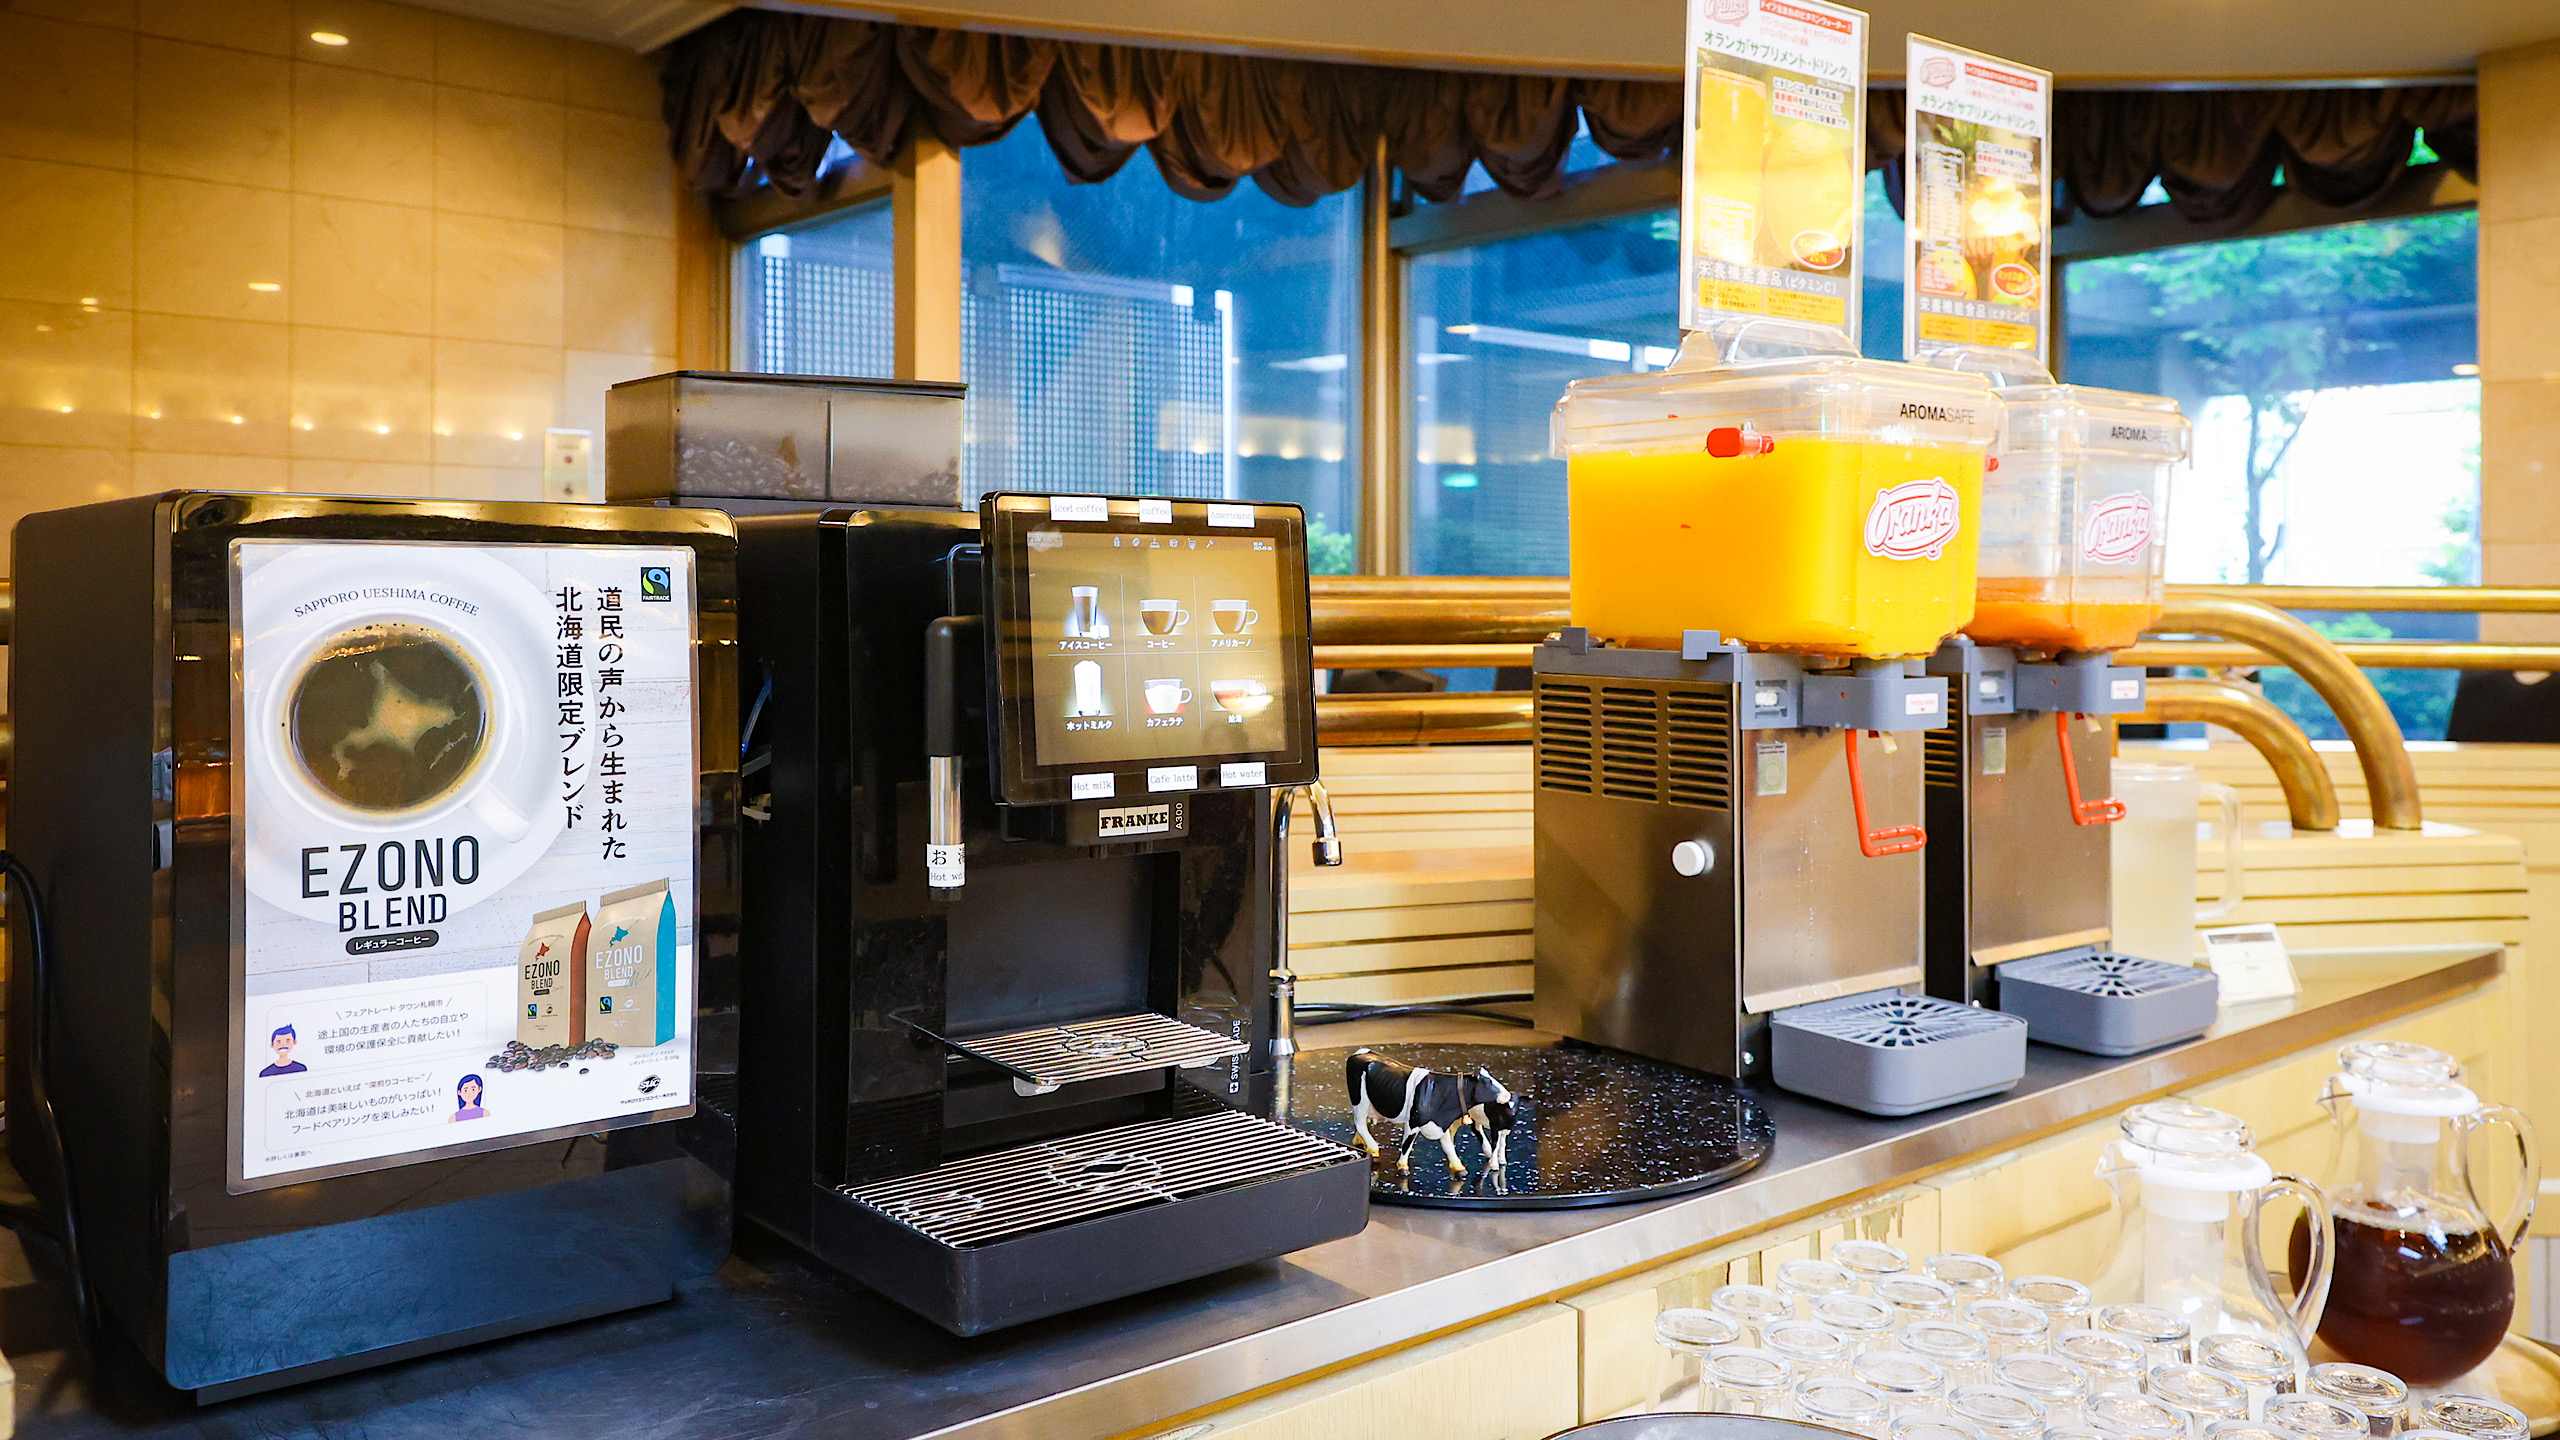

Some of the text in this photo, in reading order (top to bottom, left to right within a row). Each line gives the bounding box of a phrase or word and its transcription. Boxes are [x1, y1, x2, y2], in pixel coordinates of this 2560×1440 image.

[1900, 403, 1976, 424] AROMASAFE
[294, 588, 480, 617] SAPPORO UESHIMA COFFEE
[1058, 640, 1113, 650] アイスコーヒー
[1147, 640, 1176, 648] コーヒー
[1211, 639, 1251, 648] アメリカーノ
[555, 586, 586, 829] 北海道限定ブレンド
[597, 587, 628, 860] 道民の声から生まれた
[1066, 720, 1113, 731] ホットミルク
[1146, 717, 1184, 727] カフェラテ
[1222, 769, 1264, 779] Hot water
[1073, 780, 1112, 791] Hot milk
[1100, 811, 1168, 830] FRANKE
[1175, 803, 1183, 830] A300
[301, 835, 480, 899] EZONO
[931, 872, 946, 881] Hot
[339, 893, 447, 933] BLEND
[355, 935, 430, 950] レギュラーコーヒー
[595, 944, 644, 969] EZONO
[524, 959, 560, 980] EZONO
[604, 967, 634, 980] BLEND
[531, 977, 553, 990] BLEND
[345, 1005, 396, 1018] フェアトレード
[1233, 1020, 1241, 1040] ADE
